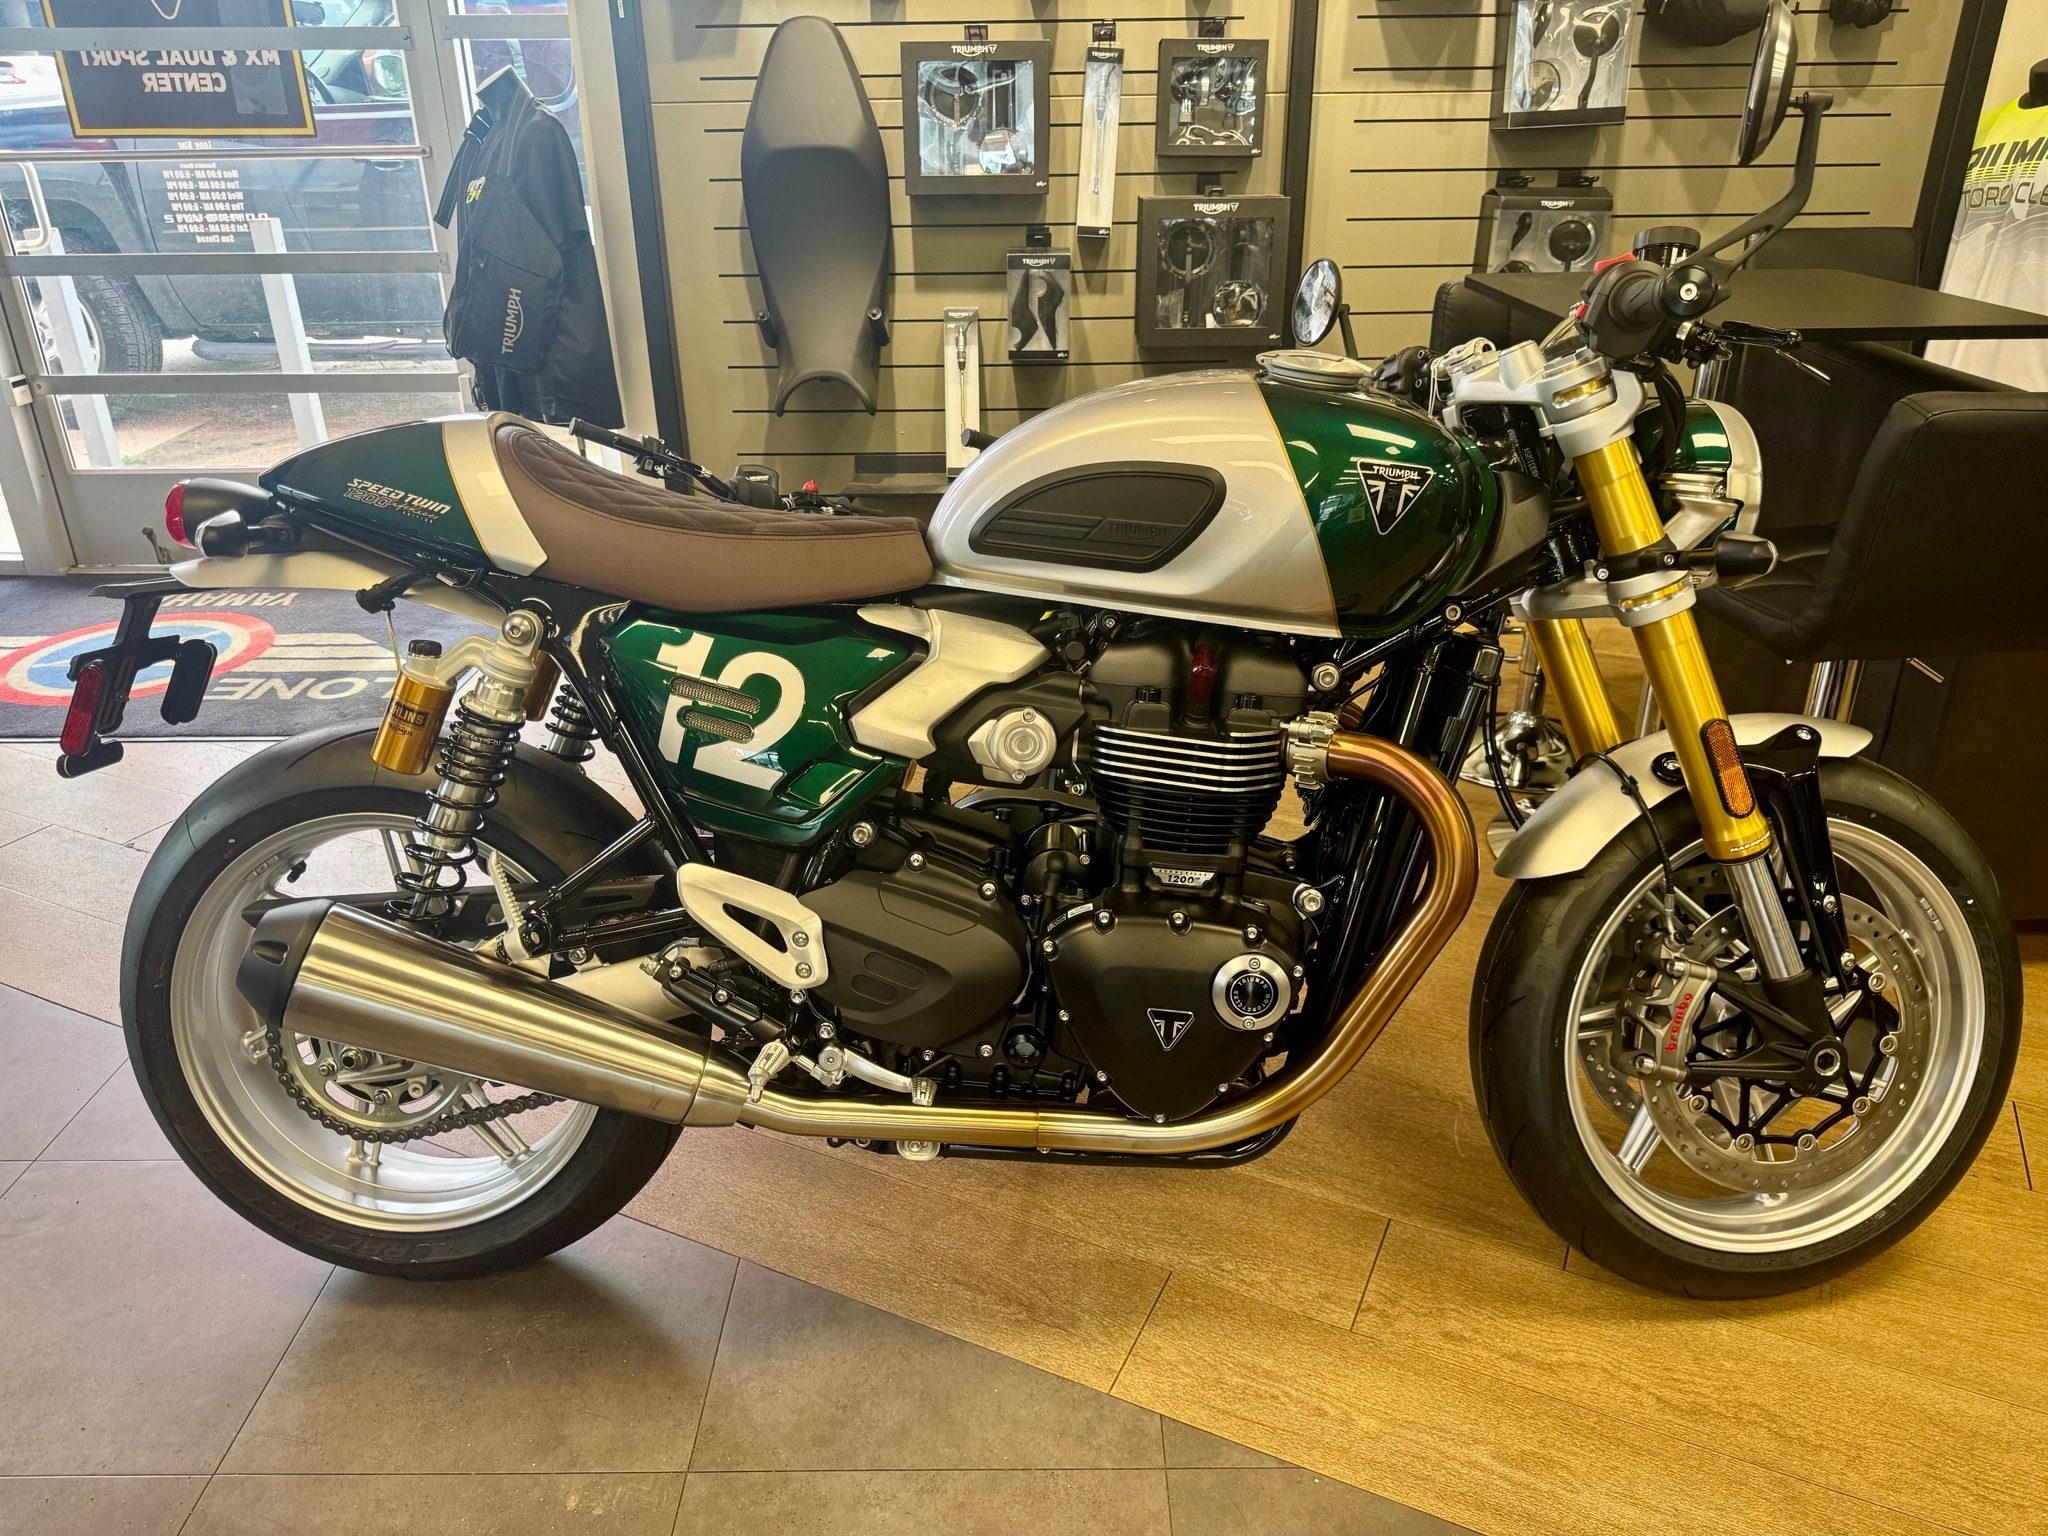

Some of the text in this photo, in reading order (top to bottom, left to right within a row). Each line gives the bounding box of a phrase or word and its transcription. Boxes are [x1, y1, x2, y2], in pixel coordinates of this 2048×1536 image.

[951, 45, 989, 57] TRIUMPH
[1196, 44, 1228, 54] TRIUMPH
[1193, 203, 1231, 215] TRIUMPH
[1541, 200, 1569, 210] TRIUMPH
[1022, 259, 1050, 267] TRIUMPH
[501, 287, 522, 355] TRIUMPH
[1373, 466, 1419, 481] TRIUMPH
[343, 487, 392, 508] 1200
[347, 478, 453, 515] SPEED TWIN
[1108, 522, 1168, 541] TRIUMPH
[161, 592, 299, 608] YAMAH
[656, 632, 806, 791] 12
[1167, 874, 1195, 885] 1200
[1237, 976, 1269, 990] TRIUMPH
[1233, 990, 1271, 1013] MOTORCYCLES
[1663, 993, 1693, 1053] brembo
